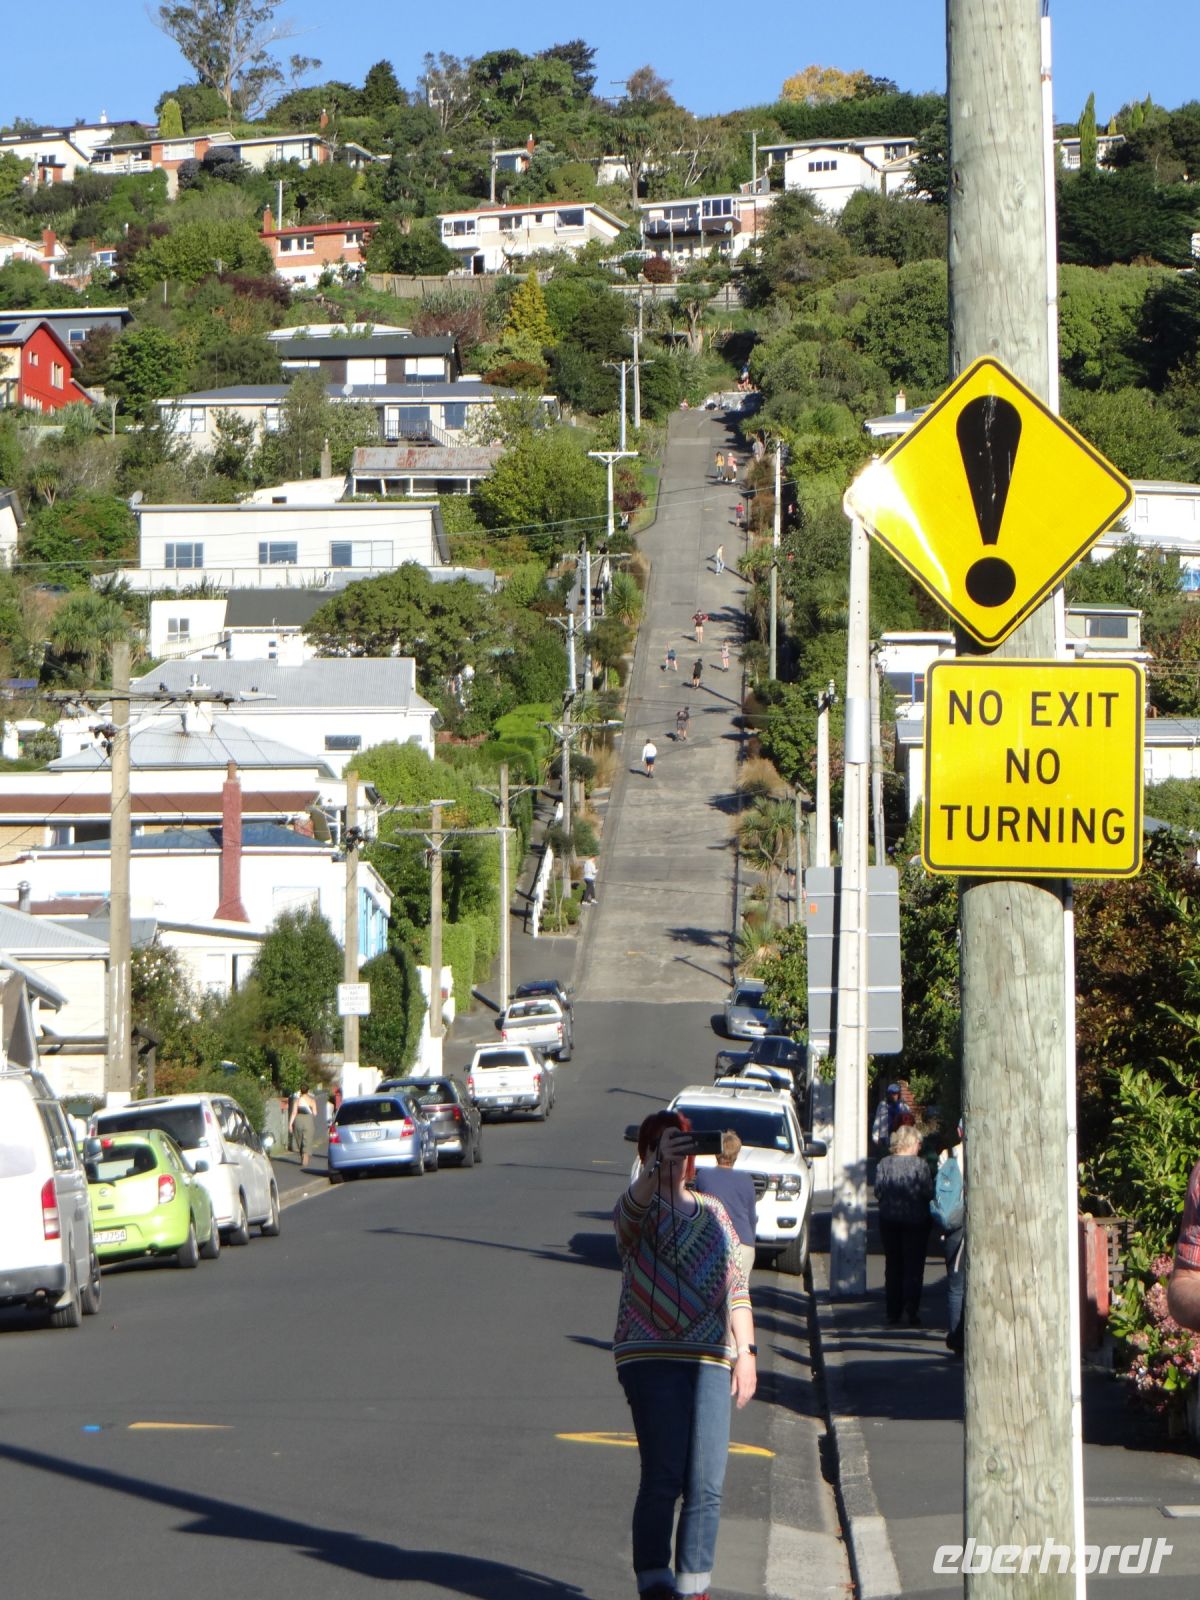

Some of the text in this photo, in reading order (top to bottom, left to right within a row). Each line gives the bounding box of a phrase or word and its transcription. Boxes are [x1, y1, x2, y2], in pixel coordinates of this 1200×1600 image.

[948, 690, 1119, 728] NO EXIT
[1005, 748, 1061, 785] NO
[940, 804, 1126, 845] TURNING
